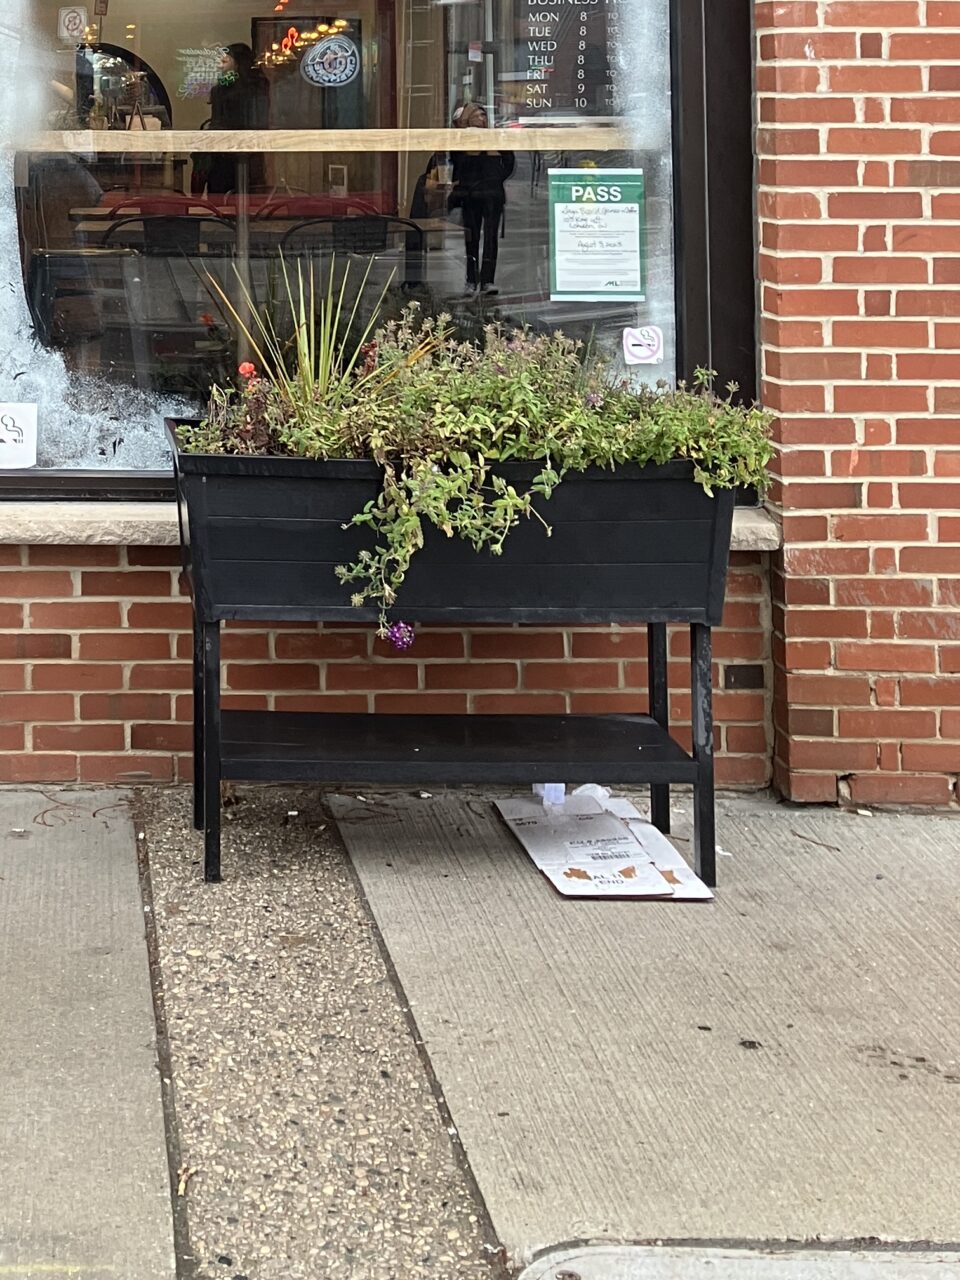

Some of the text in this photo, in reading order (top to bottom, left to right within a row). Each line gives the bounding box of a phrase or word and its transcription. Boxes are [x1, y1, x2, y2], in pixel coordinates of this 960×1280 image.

[527, 11, 560, 22] MON
[579, 11, 588, 22] 8
[528, 26, 552, 37] TUE
[579, 26, 587, 37] 8
[527, 40, 558, 51] WED
[578, 40, 586, 51] 8
[527, 55, 554, 66] THU
[577, 55, 585, 65] 8
[526, 69, 546, 80] FRI
[577, 69, 585, 80] 8
[526, 83, 548, 94] SAT
[577, 83, 585, 94] 9
[526, 98, 552, 108] SUN
[574, 97, 587, 108] 10
[571, 185, 622, 202] PASS
